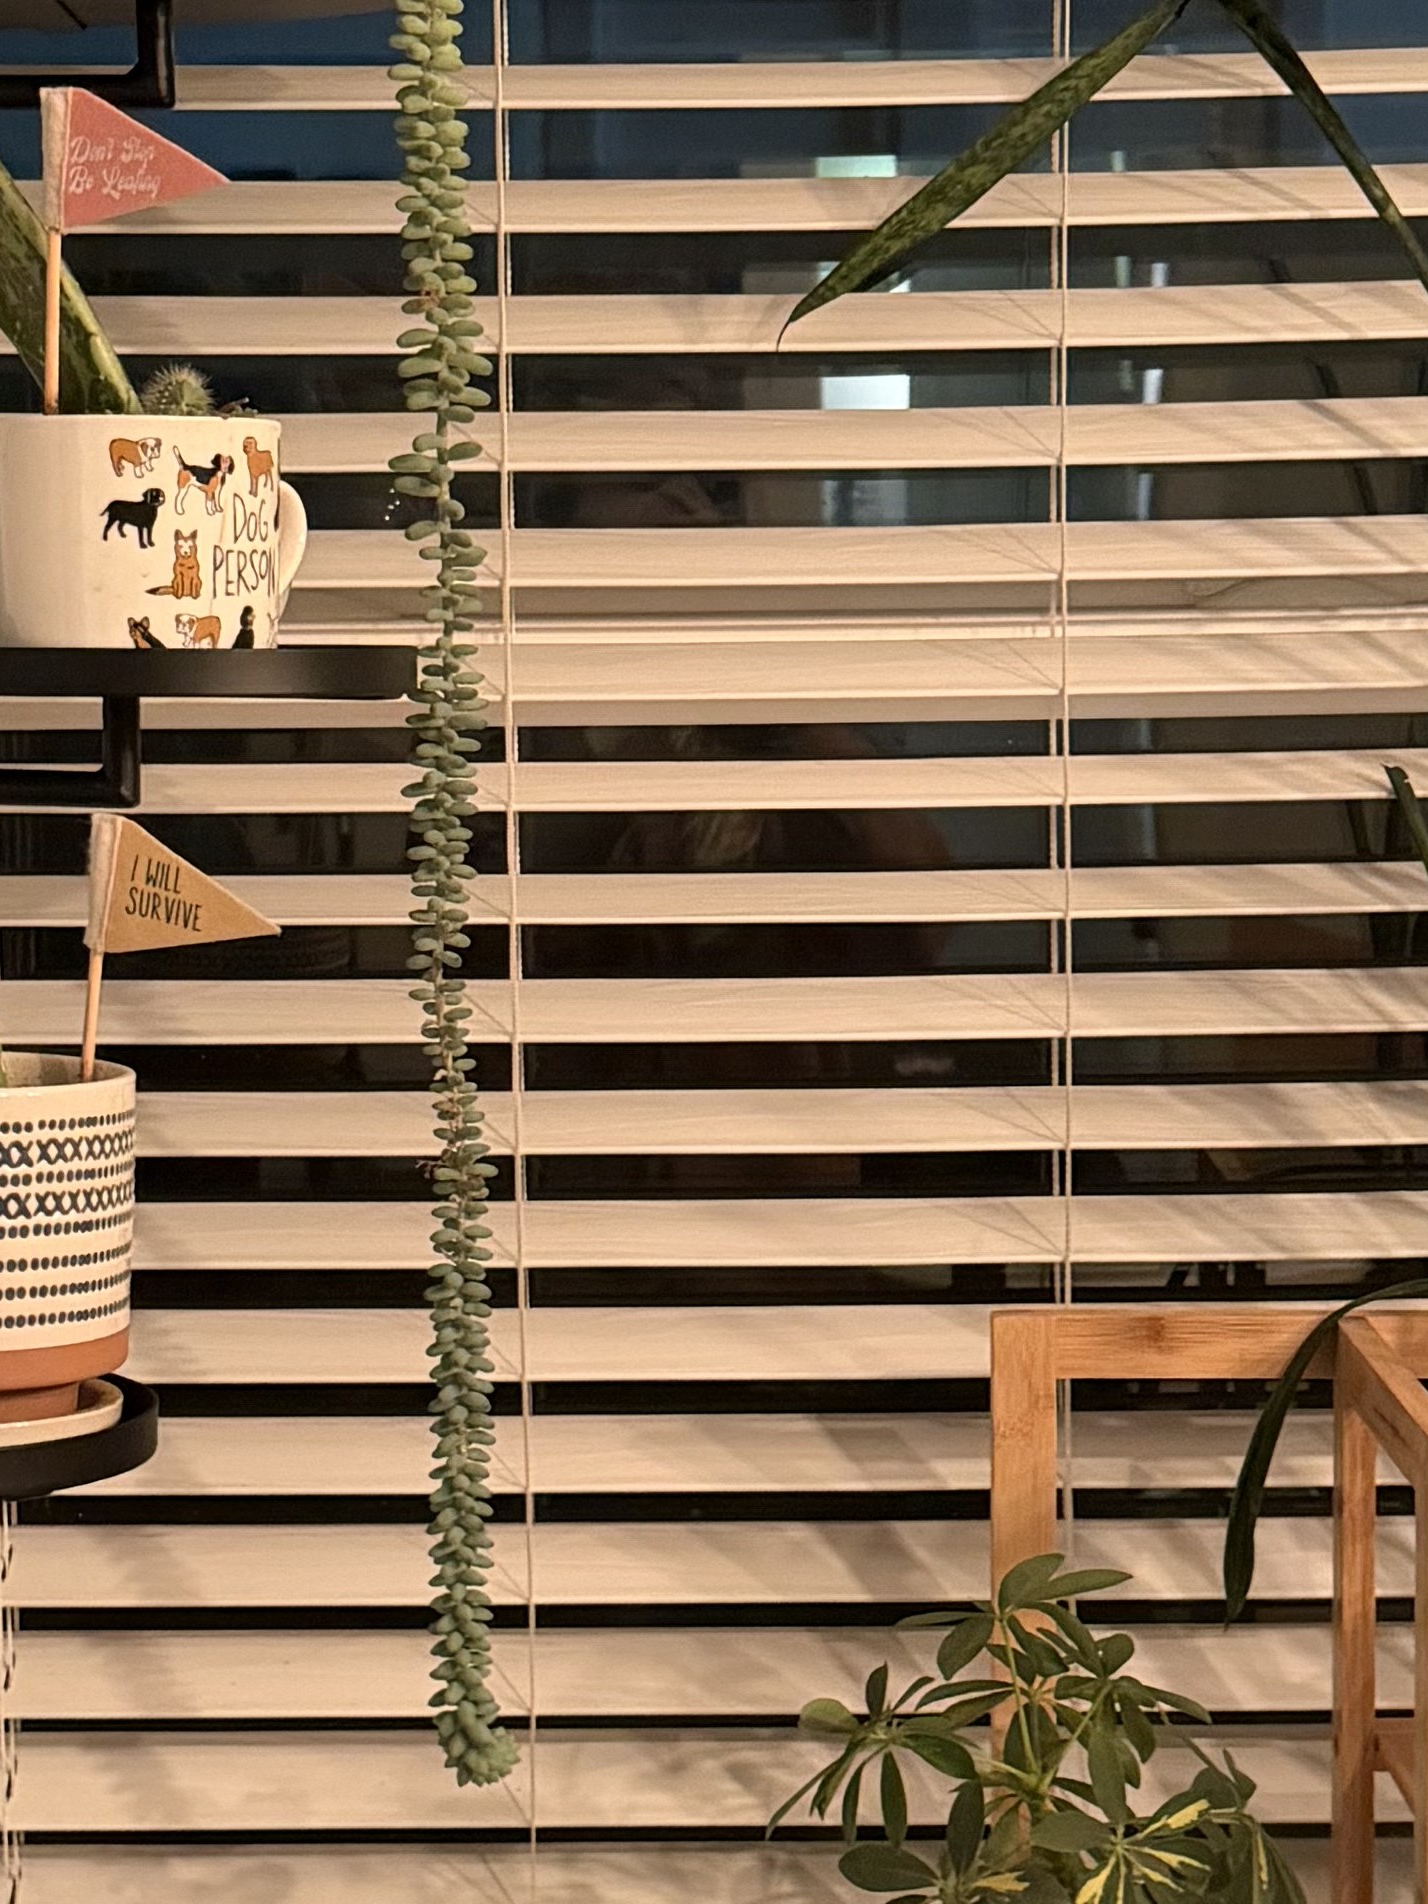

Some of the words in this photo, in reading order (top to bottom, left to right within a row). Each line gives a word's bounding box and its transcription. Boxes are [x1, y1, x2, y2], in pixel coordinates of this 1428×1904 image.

[69, 165, 94, 194] Be
[233, 492, 269, 545] DOG
[213, 544, 276, 599] PERSON
[130, 854, 139, 882] I
[145, 858, 182, 894] WILL
[125, 886, 203, 933] SURVIVE
